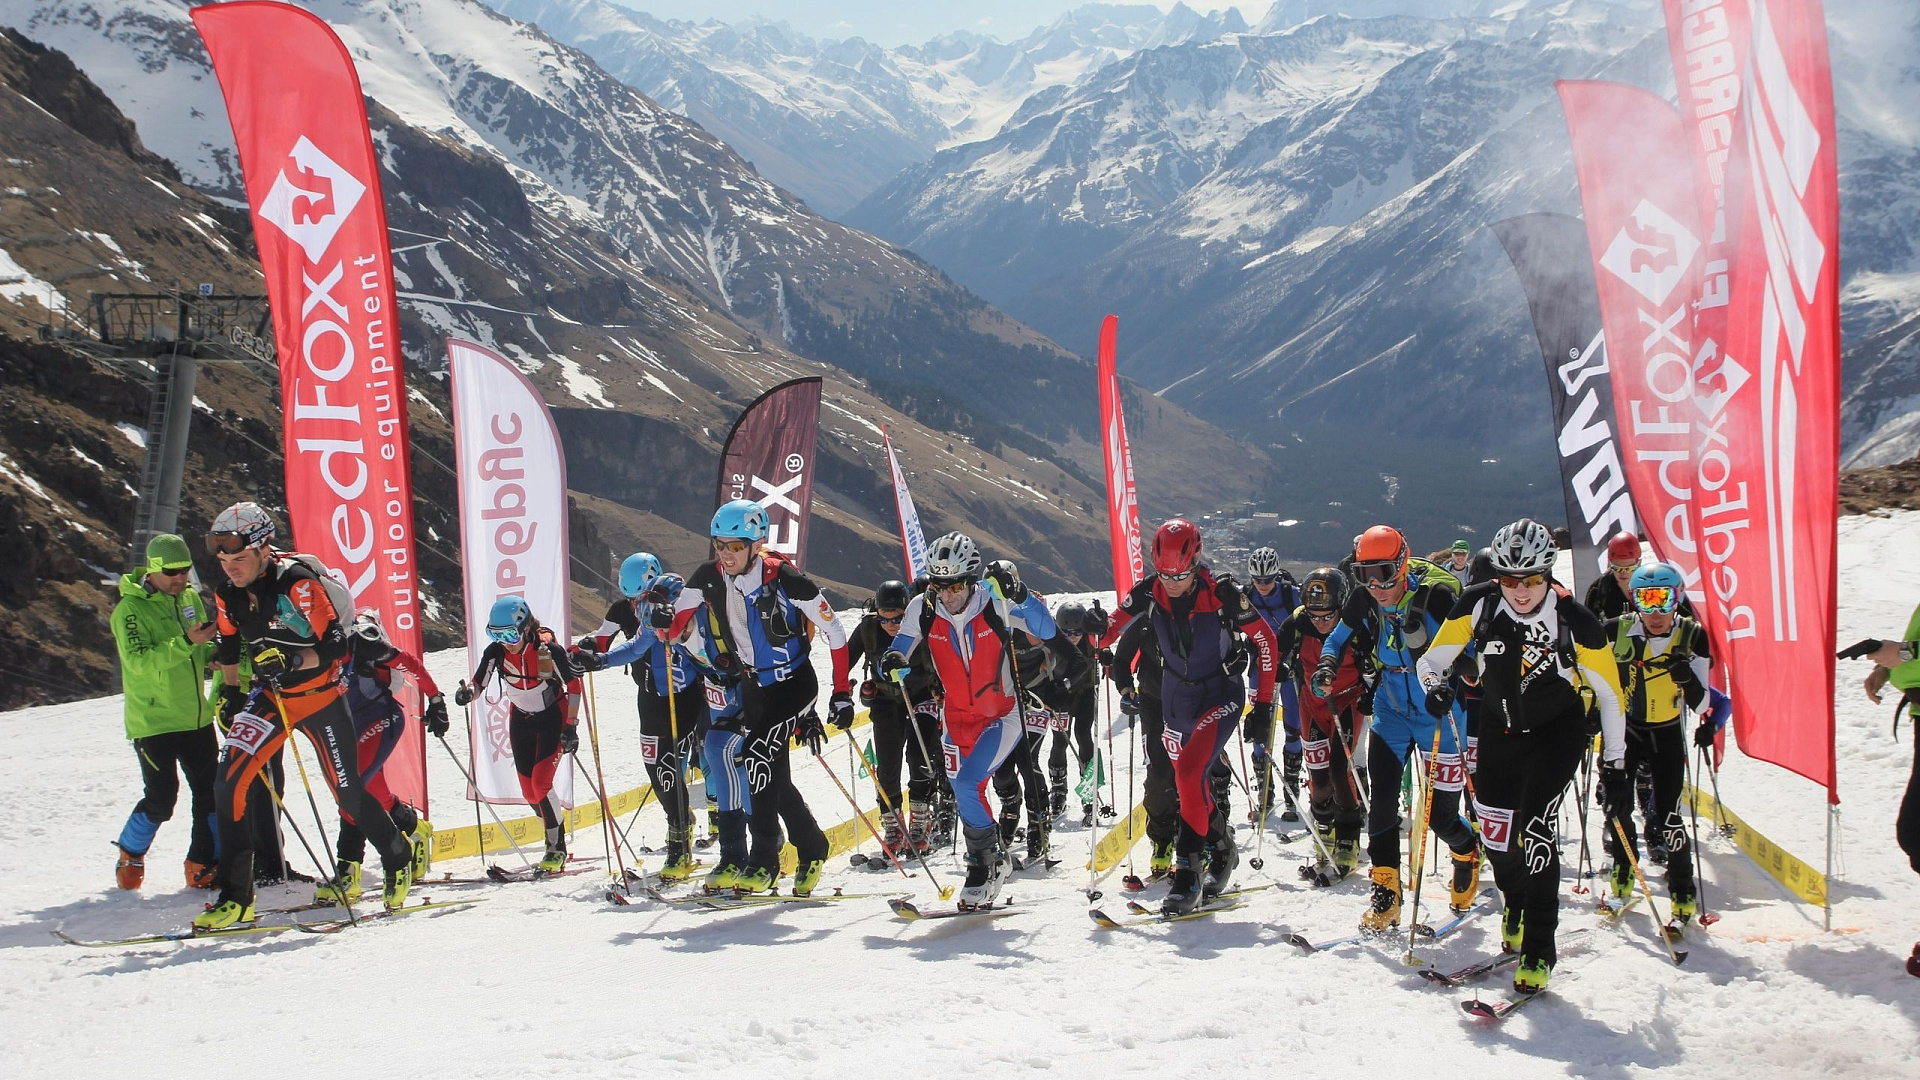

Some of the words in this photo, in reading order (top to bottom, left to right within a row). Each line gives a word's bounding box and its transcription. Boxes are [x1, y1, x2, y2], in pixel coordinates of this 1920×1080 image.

[353, 253, 400, 460] equipment
[293, 259, 377, 603] RedFox
[384, 478, 415, 630] outdoor
[935, 565, 949, 576] 23
[1253, 630, 1273, 672] RUSSIA
[1520, 652, 1557, 694] SKITRA
[359, 713, 400, 743] RUSSA
[1028, 715, 1046, 727] 02
[1196, 701, 1240, 731] RUSSIA
[229, 724, 257, 742] 33
[324, 725, 337, 748] TEAM
[333, 749, 343, 768] RACE
[1429, 754, 1437, 793] carbon
[1432, 764, 1462, 783] 12
[336, 768, 349, 788] ATK
